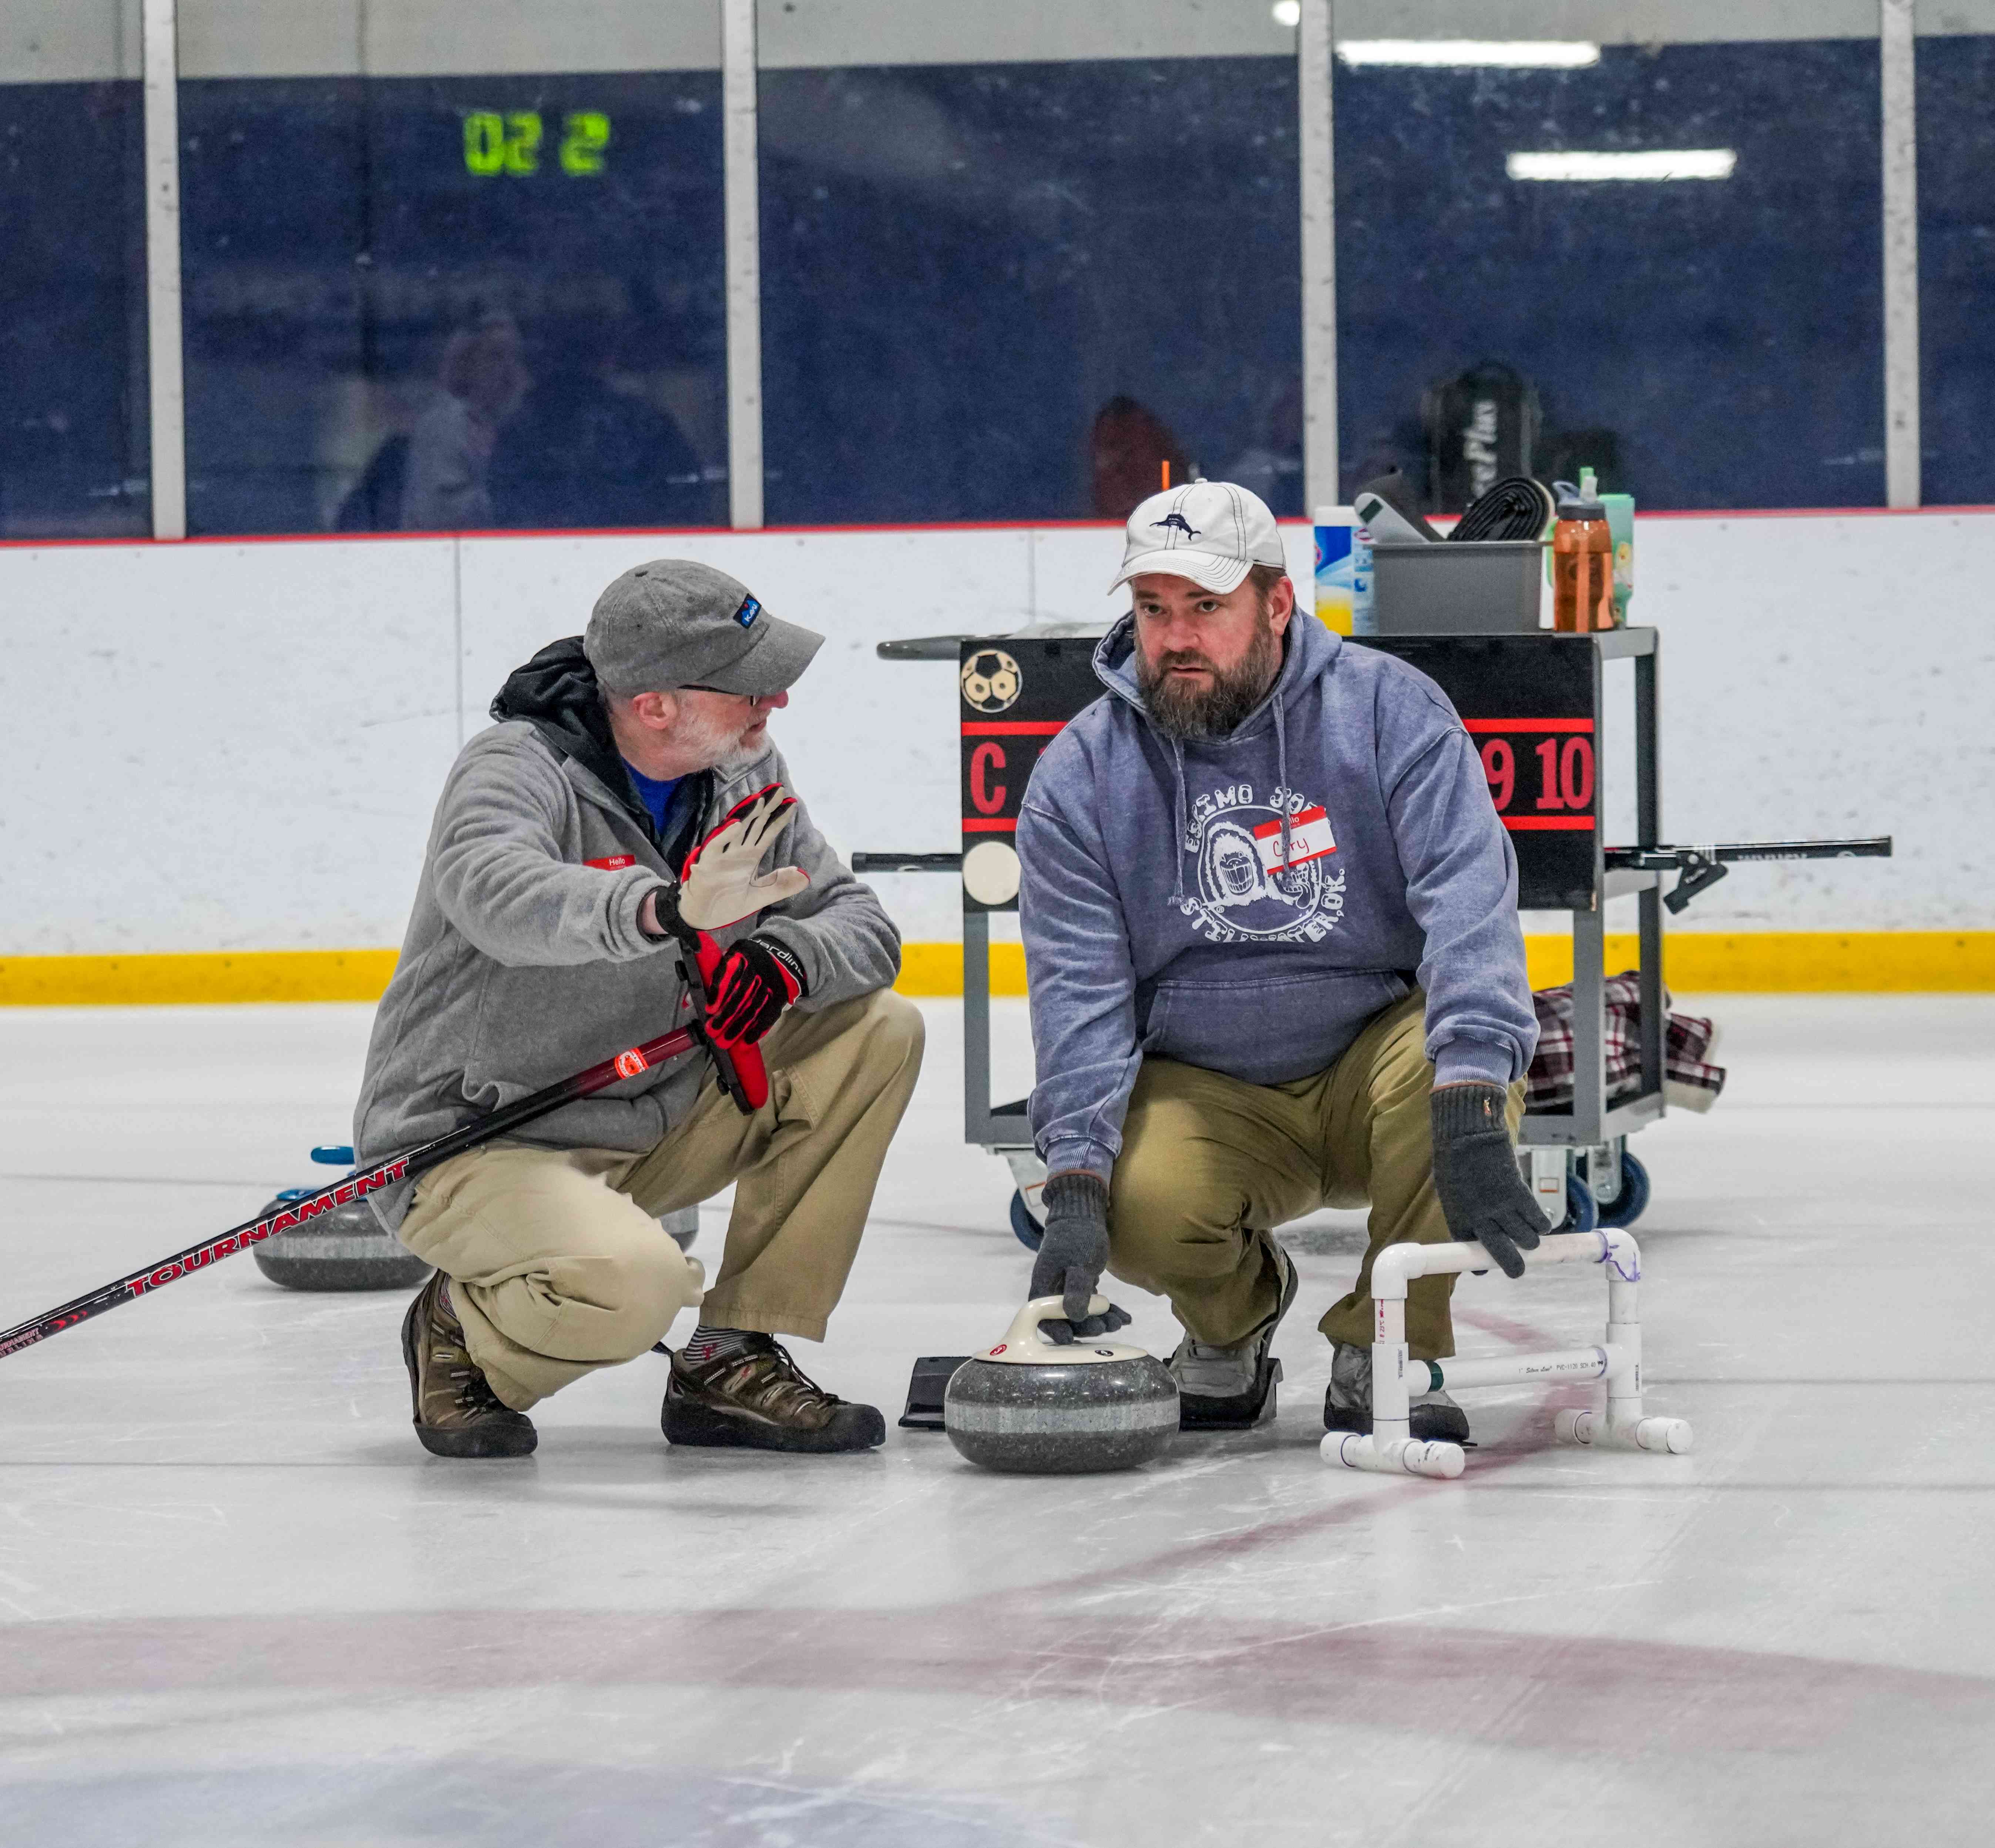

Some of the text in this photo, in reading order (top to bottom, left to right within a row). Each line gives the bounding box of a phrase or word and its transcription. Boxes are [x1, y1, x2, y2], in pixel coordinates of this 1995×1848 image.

[970, 737, 1595, 814] C 9 10
[609, 857, 625, 866] Hello
[1273, 838, 1310, 857] Cry
[748, 939, 803, 977] ardlin
[126, 1156, 409, 1298] TOURNAMENT
